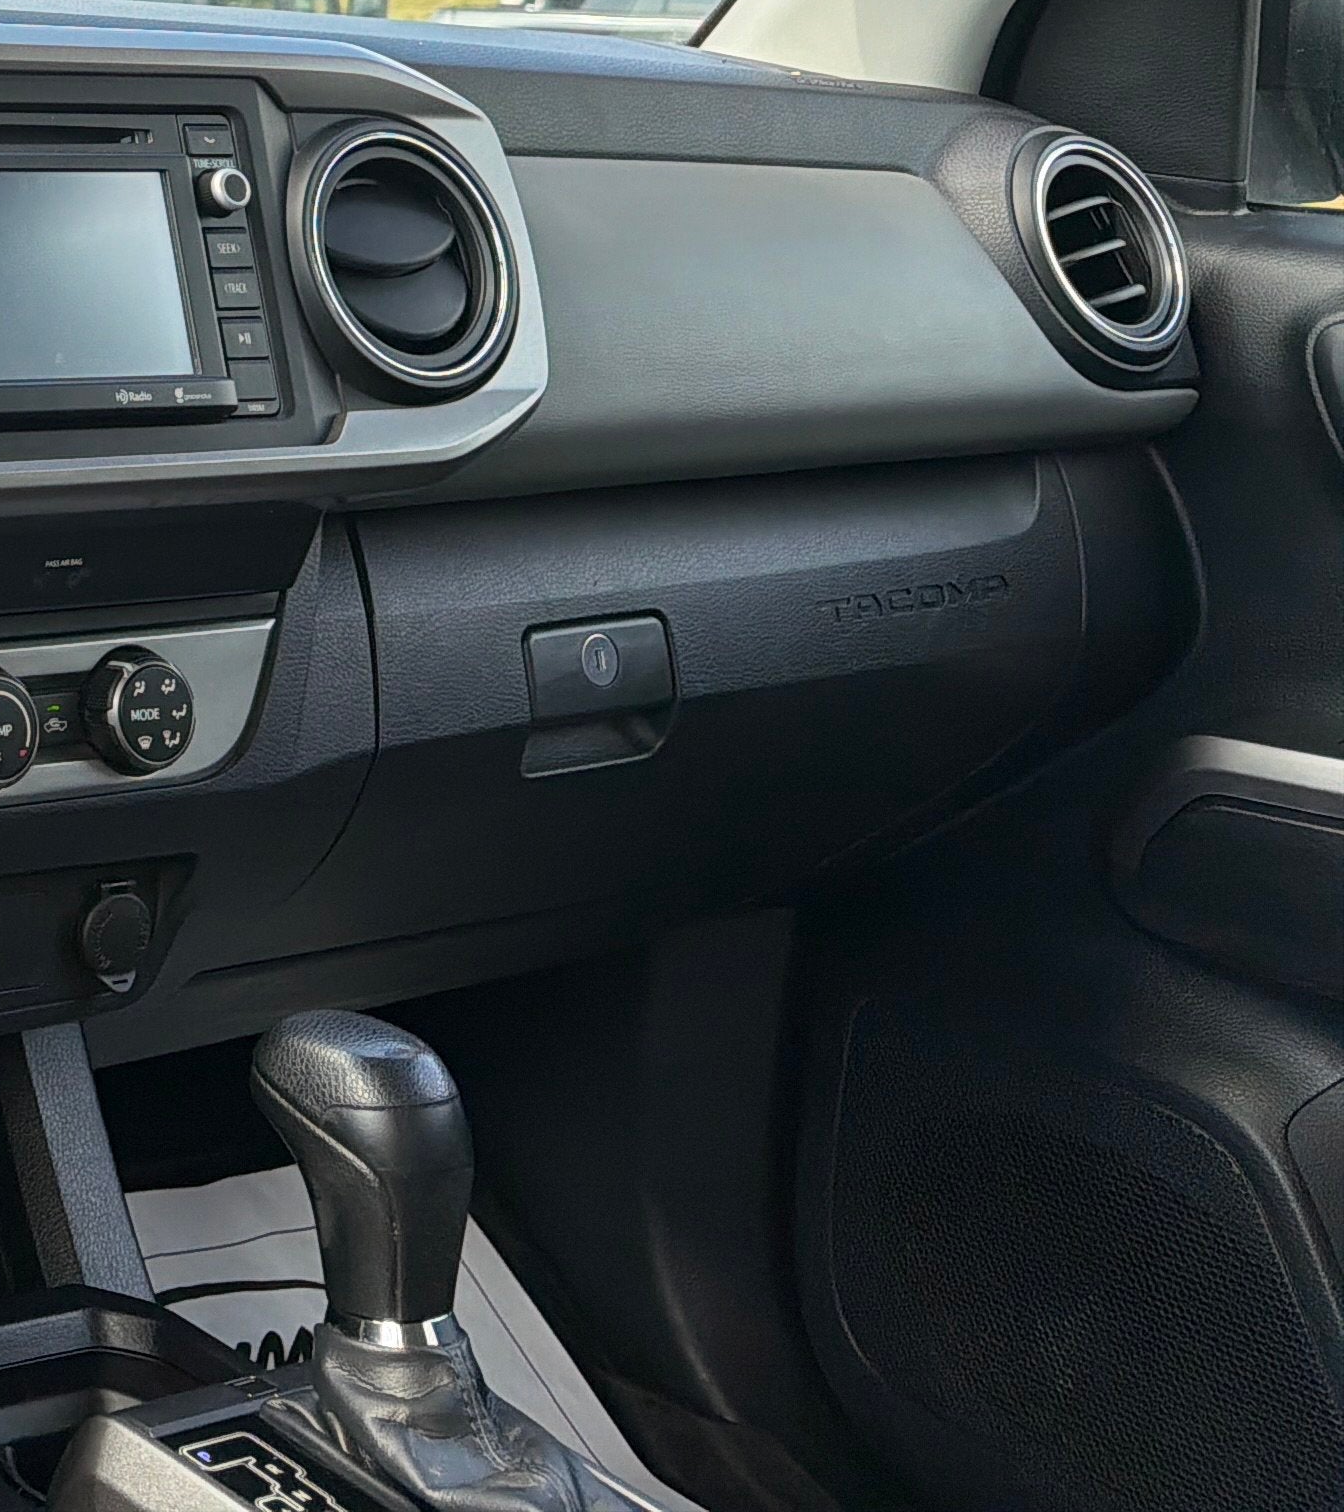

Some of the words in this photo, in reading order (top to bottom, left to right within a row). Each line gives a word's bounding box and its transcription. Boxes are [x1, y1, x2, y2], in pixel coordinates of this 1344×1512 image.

[129, 391, 153, 403] Radio
[130, 708, 160, 722] MODE
[291, 1489, 313, 1503] N
